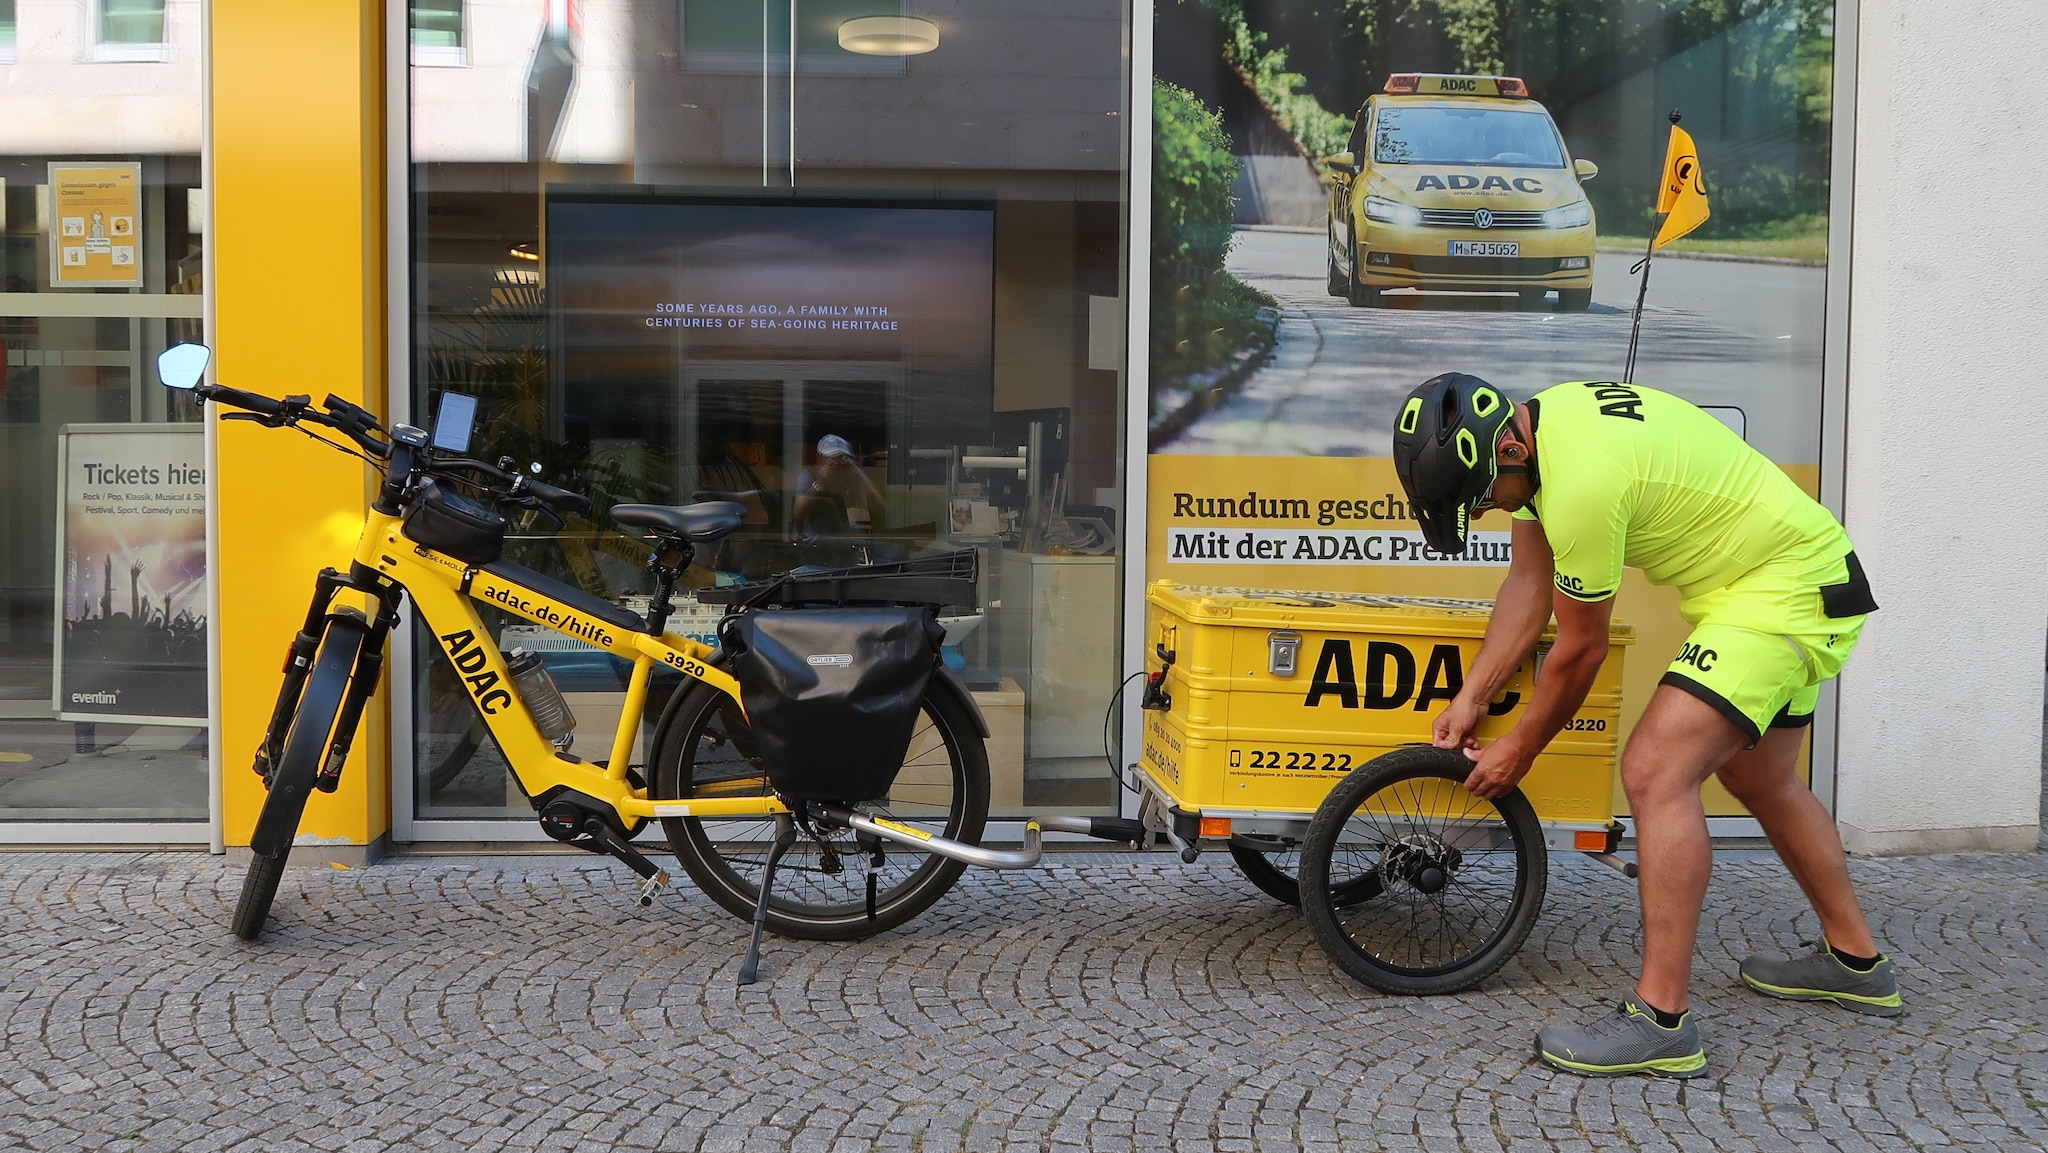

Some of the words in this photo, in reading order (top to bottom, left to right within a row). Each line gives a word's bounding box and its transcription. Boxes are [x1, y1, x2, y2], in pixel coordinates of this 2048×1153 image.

[1440, 79, 1476, 92] ADAC
[1415, 175, 1543, 194] ADAC
[656, 303, 694, 313] SOME
[700, 304, 744, 314] YEARS
[749, 304, 781, 316] AGO,
[787, 305, 796, 315] A
[801, 306, 849, 316] FAMILY
[854, 306, 888, 316] WITH
[645, 317, 723, 328] CENTURIES
[727, 318, 745, 328] OF
[750, 319, 827, 330] SEA-GOING
[832, 320, 898, 331] HERITAGE
[83, 463, 160, 485] Tickets
[82, 492, 100, 501] Rock
[107, 493, 124, 502] Pop,
[125, 493, 153, 501] Klassik,
[155, 493, 184, 501] Musical
[1173, 492, 1310, 519] Rundum
[85, 506, 115, 514] Festival,
[141, 506, 174, 516] Comedy
[175, 507, 190, 515] und
[1456, 502, 1466, 542] ALPINA
[1172, 531, 1229, 559] Mit
[1236, 532, 1287, 560] der
[1293, 535, 1382, 561] ADAC
[1389, 534, 1512, 562] Preiu
[1555, 571, 1584, 592] DAC
[484, 585, 613, 648] adac.de/hilfe
[664, 651, 705, 678] 3920
[1674, 642, 1718, 672] DAC
[441, 629, 512, 715] ADAC
[72, 690, 117, 704] eventim
[1146, 742, 1179, 785] adac.de/hilfe
[1250, 751, 1281, 769] 22
[1285, 751, 1316, 771] 22
[1321, 753, 1352, 772] 22
